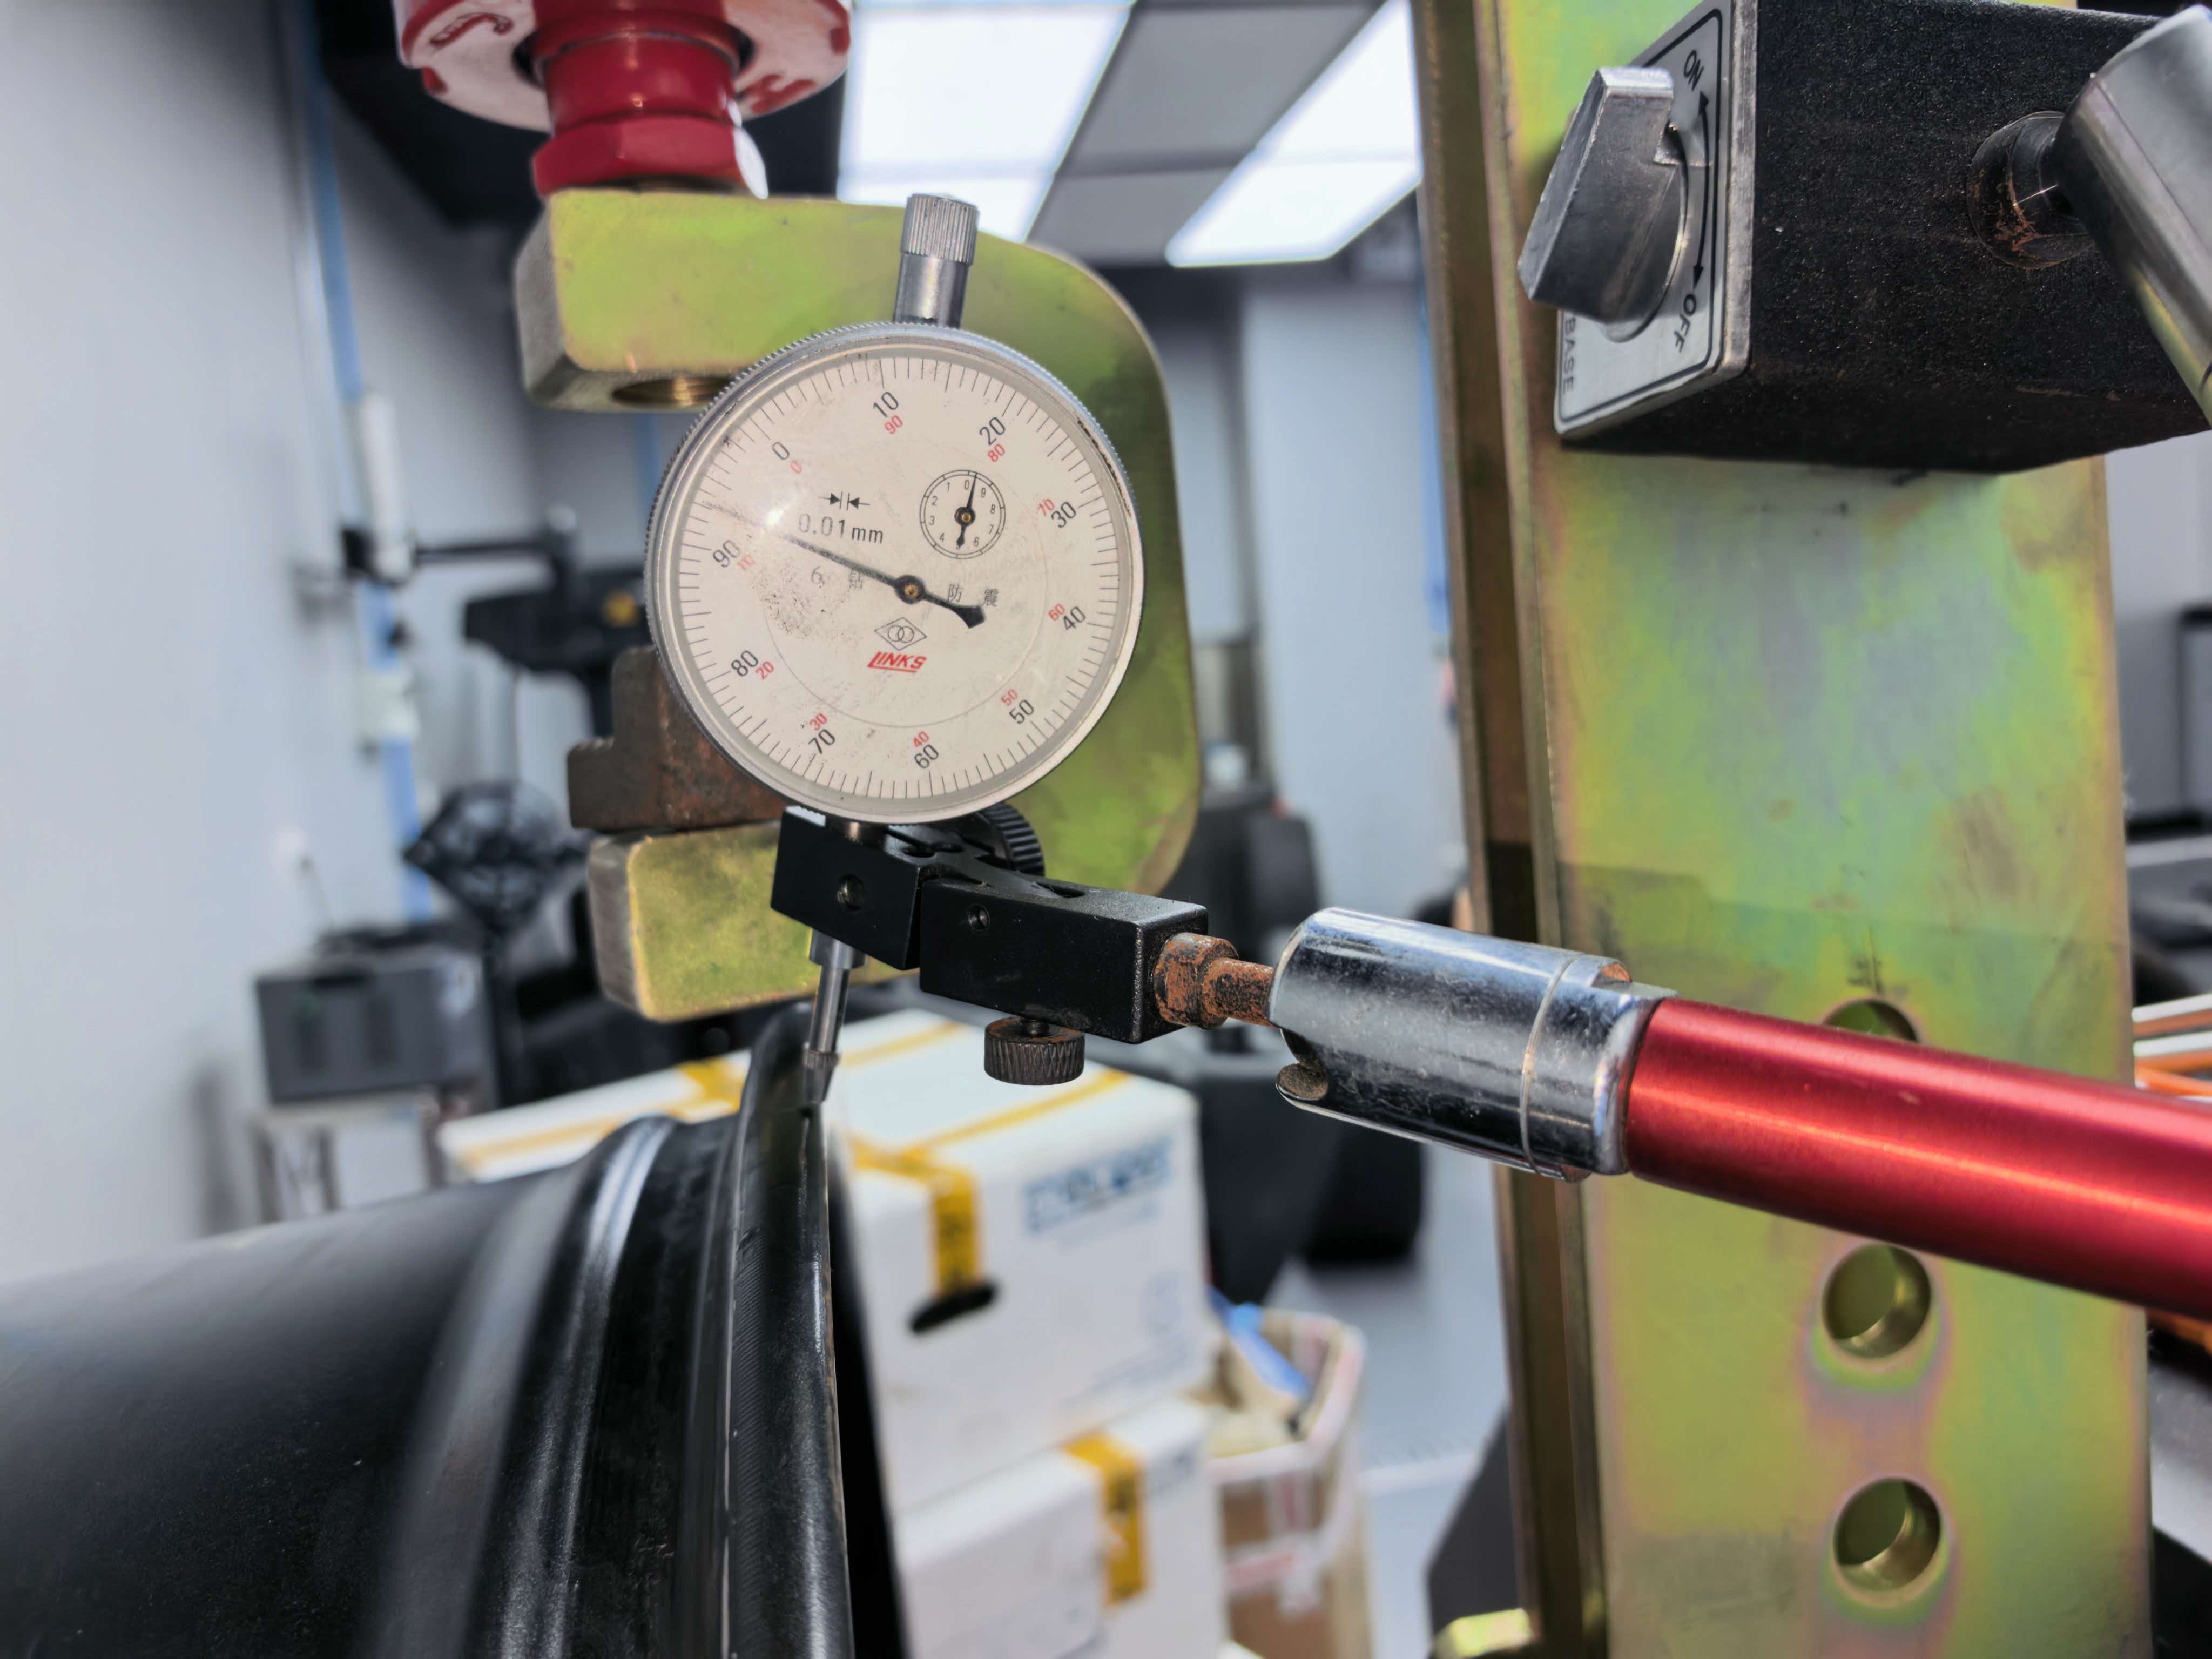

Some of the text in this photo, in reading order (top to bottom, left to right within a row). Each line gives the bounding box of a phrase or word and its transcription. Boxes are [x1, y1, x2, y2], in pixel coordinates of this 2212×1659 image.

[1683, 49, 1704, 92] ON
[1674, 294, 1697, 353] OFF
[1563, 317, 1576, 395] BASE
[873, 392, 899, 417] 10
[885, 415, 903, 434] 90
[979, 417, 1006, 445] 20
[772, 441, 790, 460] 0
[988, 443, 1005, 462] 80
[790, 460, 802, 474] 0
[946, 482, 950, 492] 1
[964, 480, 970, 490] 0
[981, 488, 986, 498] 9
[932, 496, 938, 505] 2
[990, 504, 996, 514] 8
[1037, 498, 1055, 517] 70
[929, 515, 935, 525] 3
[1051, 502, 1076, 528] 30
[940, 532, 945, 542] 4
[989, 524, 994, 534] 7
[712, 539, 740, 568] 90
[1048, 603, 1065, 621] 60
[1063, 606, 1086, 631] 40
[731, 650, 758, 677] 80
[756, 661, 774, 680] 20
[867, 651, 927, 673] LINKS
[1001, 689, 1018, 706] 50
[809, 712, 827, 731] 30
[1009, 700, 1034, 724] 50
[808, 729, 835, 754] 70
[913, 731, 929, 747] 40
[914, 745, 939, 769] 60
